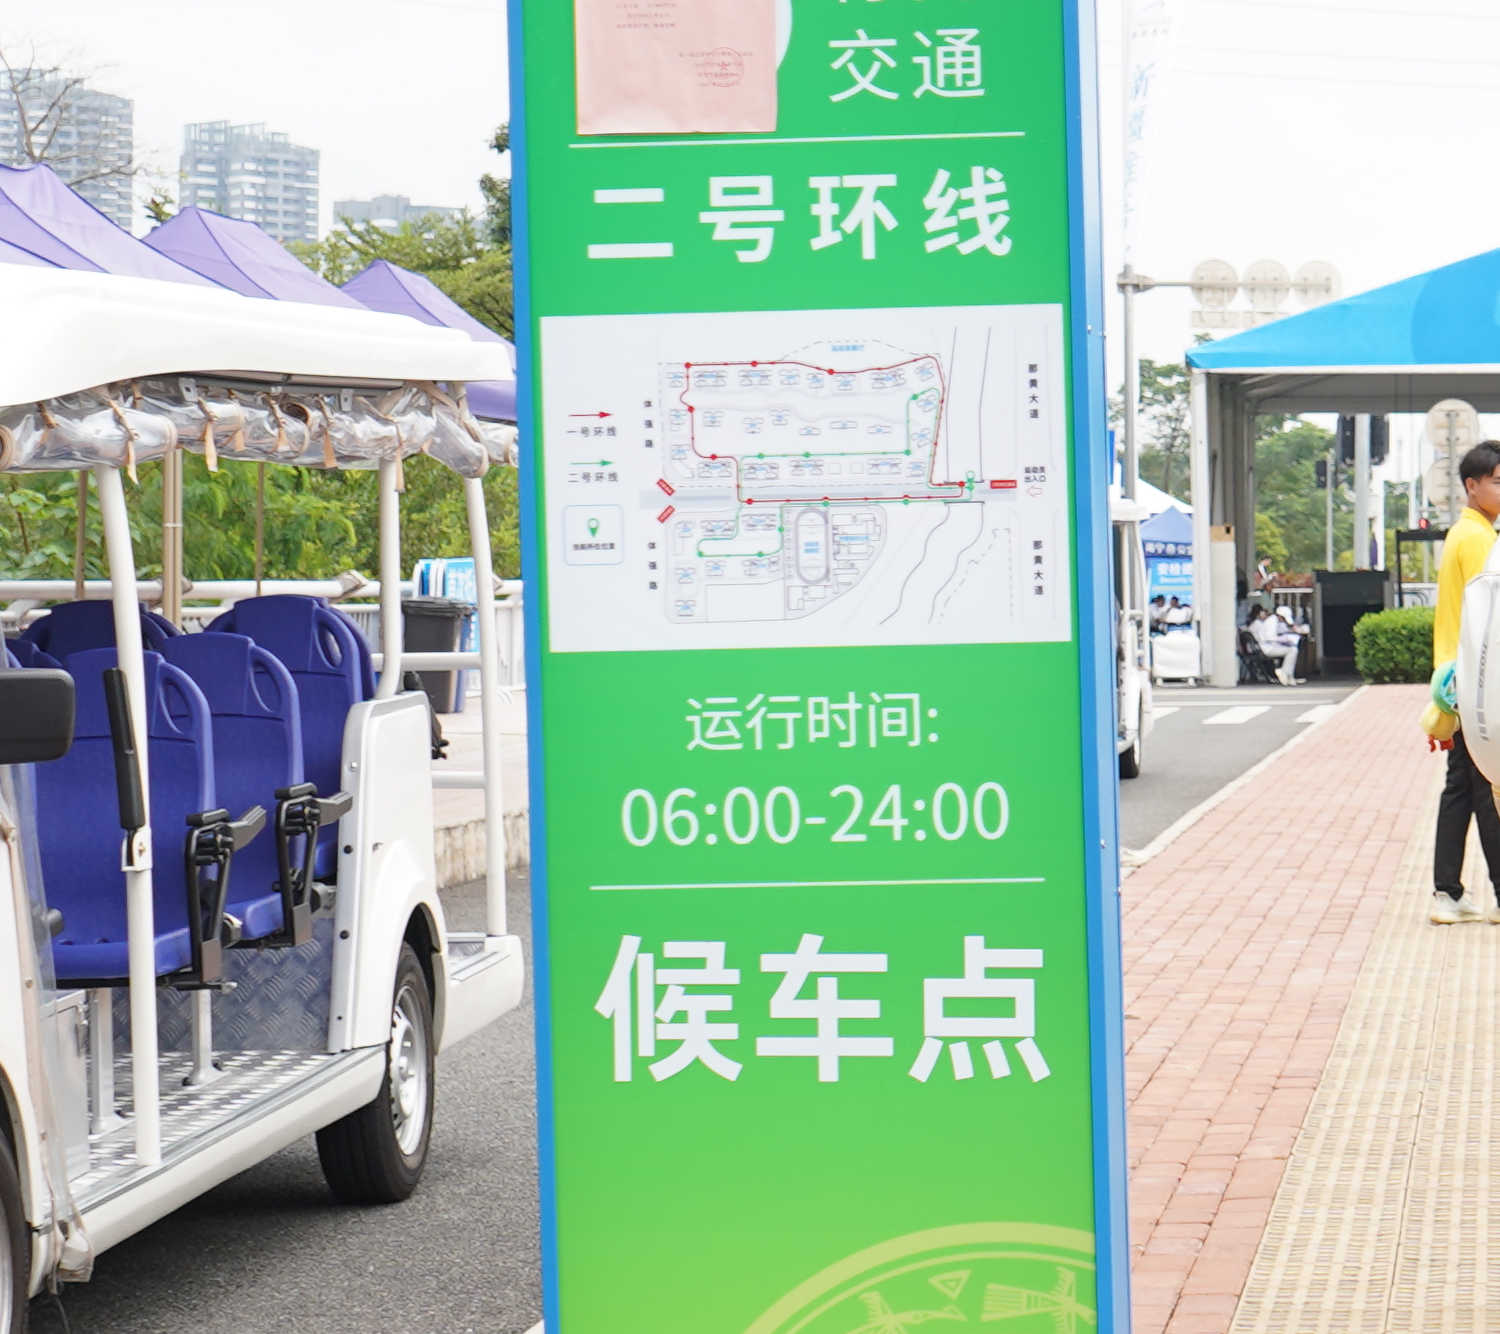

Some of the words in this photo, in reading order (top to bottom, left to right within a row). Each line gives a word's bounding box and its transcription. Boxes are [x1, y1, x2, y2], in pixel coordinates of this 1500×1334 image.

[828, 28, 986, 103] 交通
[586, 165, 1013, 263] 二号环线
[566, 425, 617, 438] 一号环线
[567, 471, 619, 484] 二号环线
[684, 691, 940, 752] 运行时间:
[620, 780, 1011, 847] 06:00-24:00
[593, 933, 1052, 1084] 候车点
